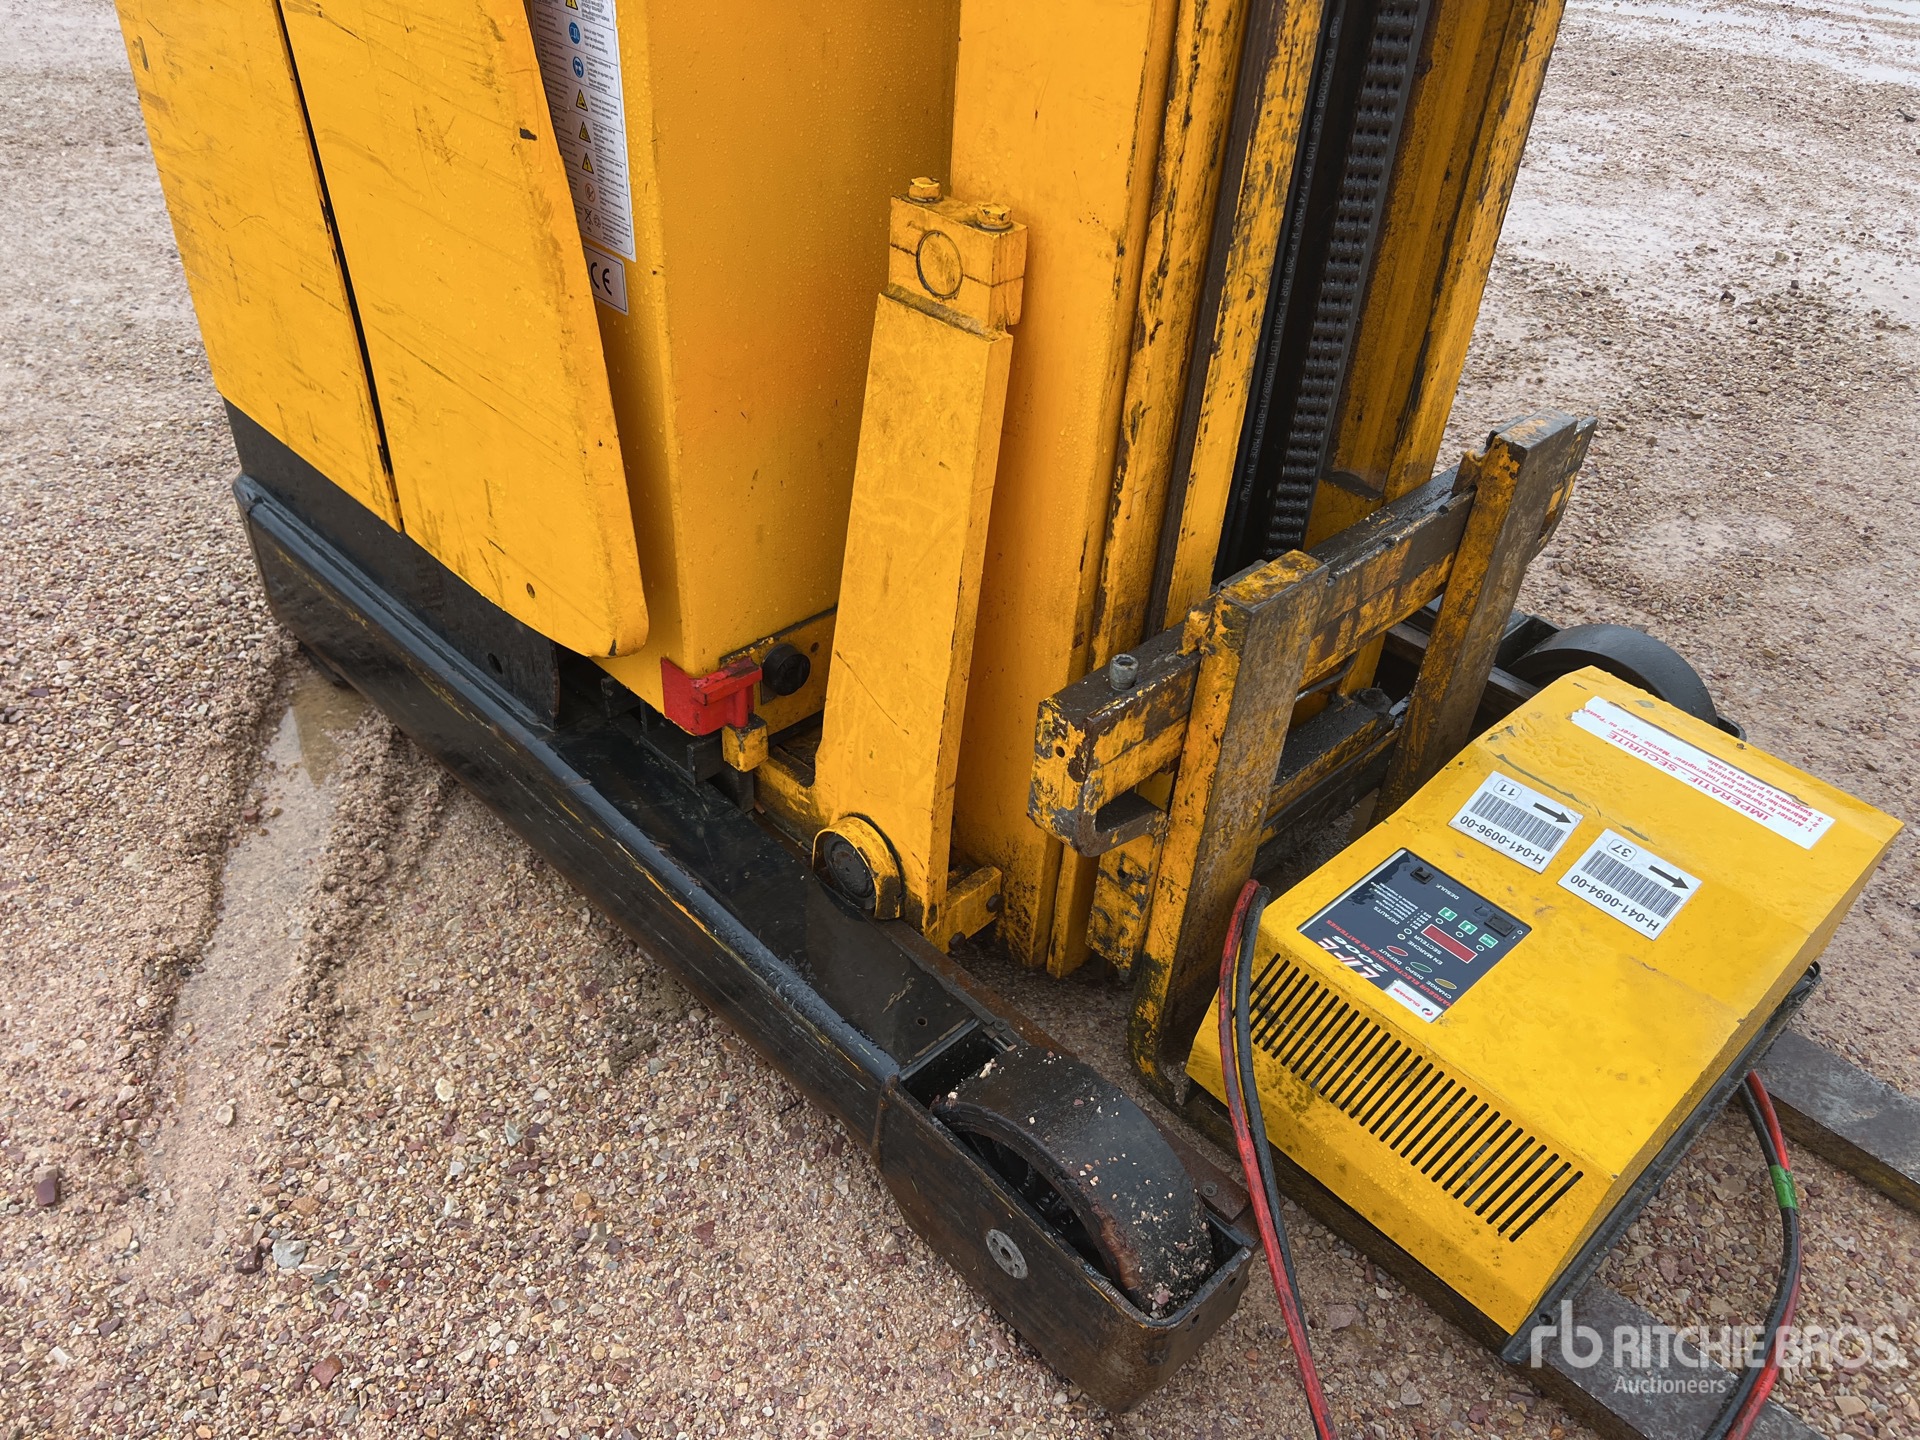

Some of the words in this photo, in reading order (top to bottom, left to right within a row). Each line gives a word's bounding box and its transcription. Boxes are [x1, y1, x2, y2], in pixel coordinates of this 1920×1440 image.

[1310, 113, 1323, 134] SAE
[1305, 140, 1317, 160] 100
[1293, 207, 1304, 227] MAX
[1284, 255, 1295, 273] 200
[1280, 277, 1291, 297] BAR
[1270, 339, 1279, 356] LOT
[1249, 437, 1261, 459] MADE
[1246, 463, 1255, 474] IN
[1240, 478, 1252, 502] ITALY
[1605, 731, 1678, 772] SECURITE
[1498, 783, 1517, 797] 11
[1719, 779, 1734, 790] par
[1744, 778, 1765, 791] prise
[1687, 774, 1769, 821] IMPERATIF
[1733, 787, 1768, 808] chargeur
[1773, 793, 1814, 817] Suspendre
[1458, 814, 1545, 864] H-041-0096-00
[1610, 841, 1633, 858] 37
[1568, 873, 1660, 931] H-041-0094-00
[1372, 905, 1400, 925] DEFAUTS
[1324, 918, 1362, 944] BATTERIES
[1329, 933, 1389, 974] 2006
[1359, 942, 1371, 951] DE
[1406, 939, 1434, 959] MARCHE
[1412, 934, 1442, 955] SECTEUR
[1377, 947, 1403, 965] DEFAUT
[1432, 956, 1443, 965] EN
[1368, 949, 1421, 985] ELECTRONIQUE
[1403, 965, 1424, 980] DISPO
[1418, 983, 1453, 1007] HARGEUR
[1424, 979, 1452, 999] CHARGE
